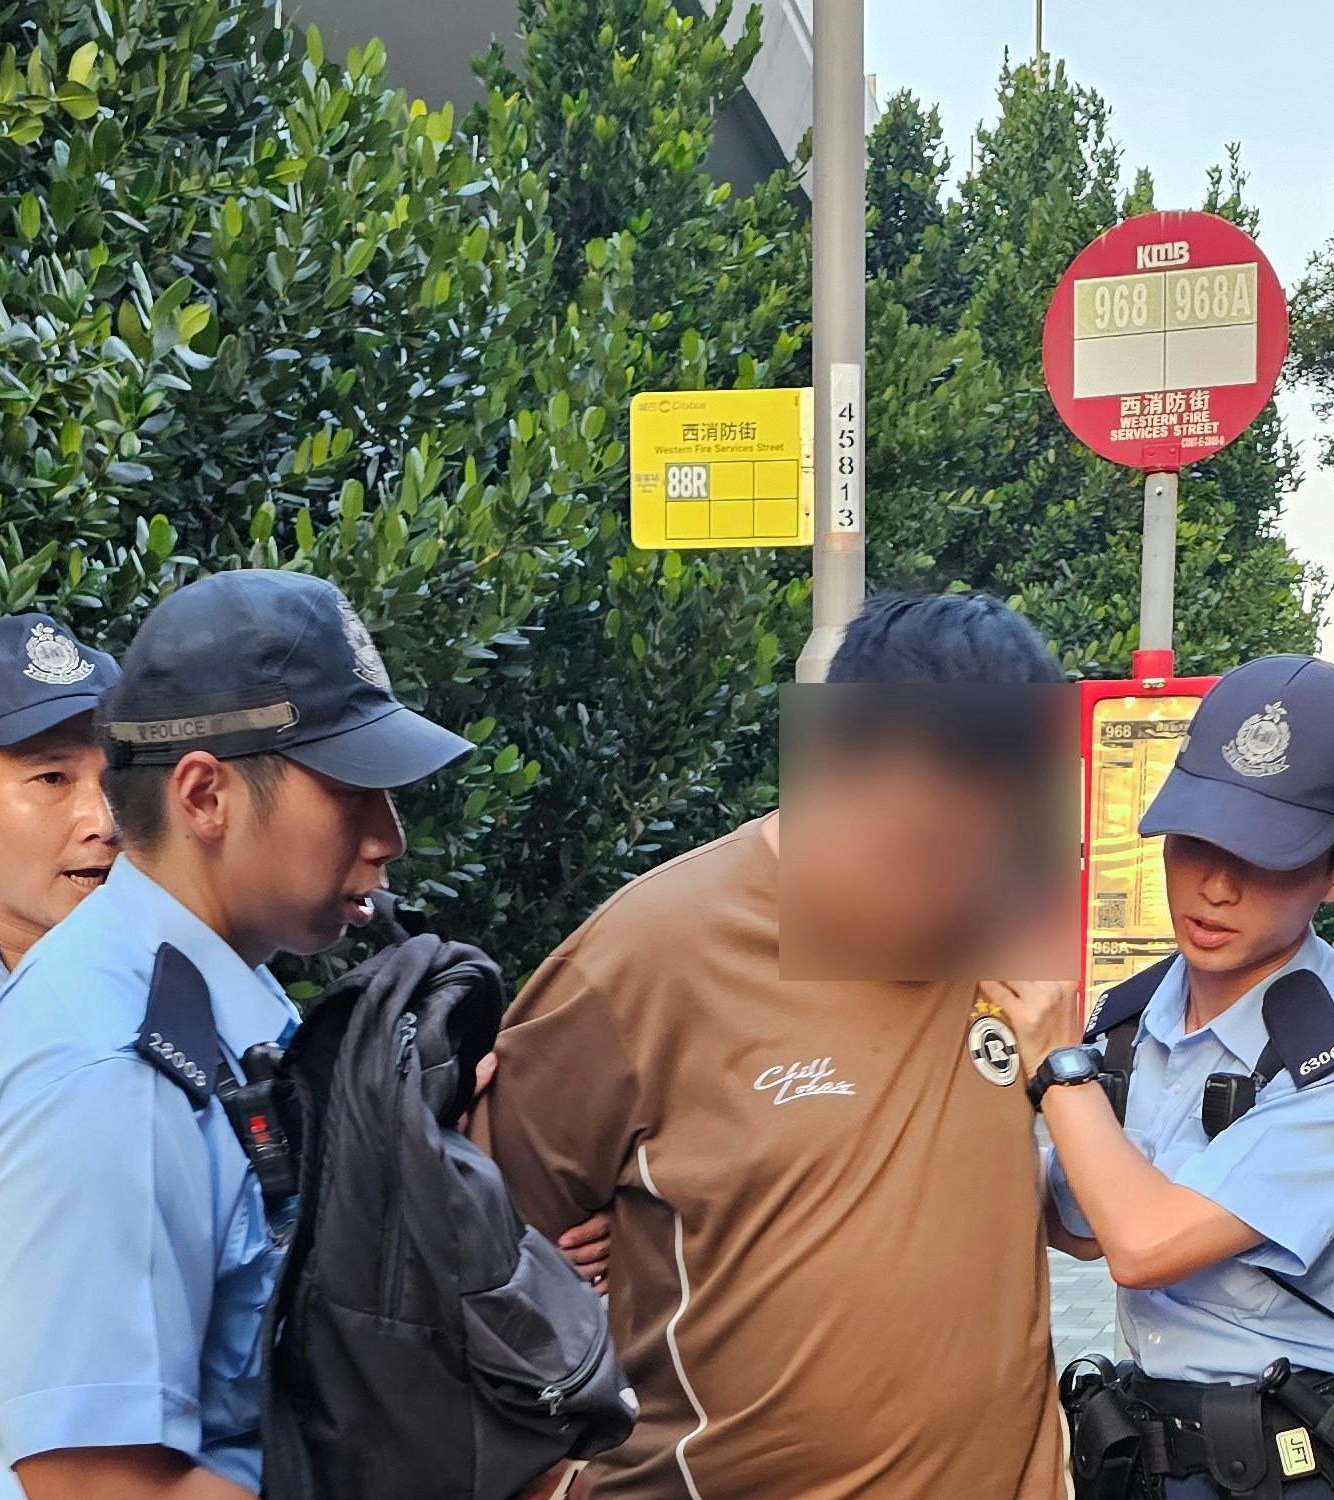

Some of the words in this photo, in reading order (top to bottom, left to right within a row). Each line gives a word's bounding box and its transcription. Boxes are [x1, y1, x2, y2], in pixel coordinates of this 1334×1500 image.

[1137, 242, 1189, 269] KMB
[1095, 283, 1147, 329] 968
[1175, 273, 1251, 322] 968A
[1121, 390, 1209, 415] 西消防街
[1120, 413, 1177, 428] WESTERN
[1183, 412, 1209, 423] FIRE
[682, 422, 757, 442] 西消防街
[1111, 425, 1168, 440] SERVICES
[1173, 422, 1219, 436] STREET
[655, 444, 693, 454] Western
[695, 444, 712, 453] Fire
[715, 444, 753, 452] Services
[757, 442, 785, 452] Street
[668, 466, 708, 498] 88R
[150, 721, 205, 739] POLICE
[1106, 725, 1131, 738] 968
[985, 1040, 1009, 1061] R
[1291, 1438, 1308, 1464] JFT
